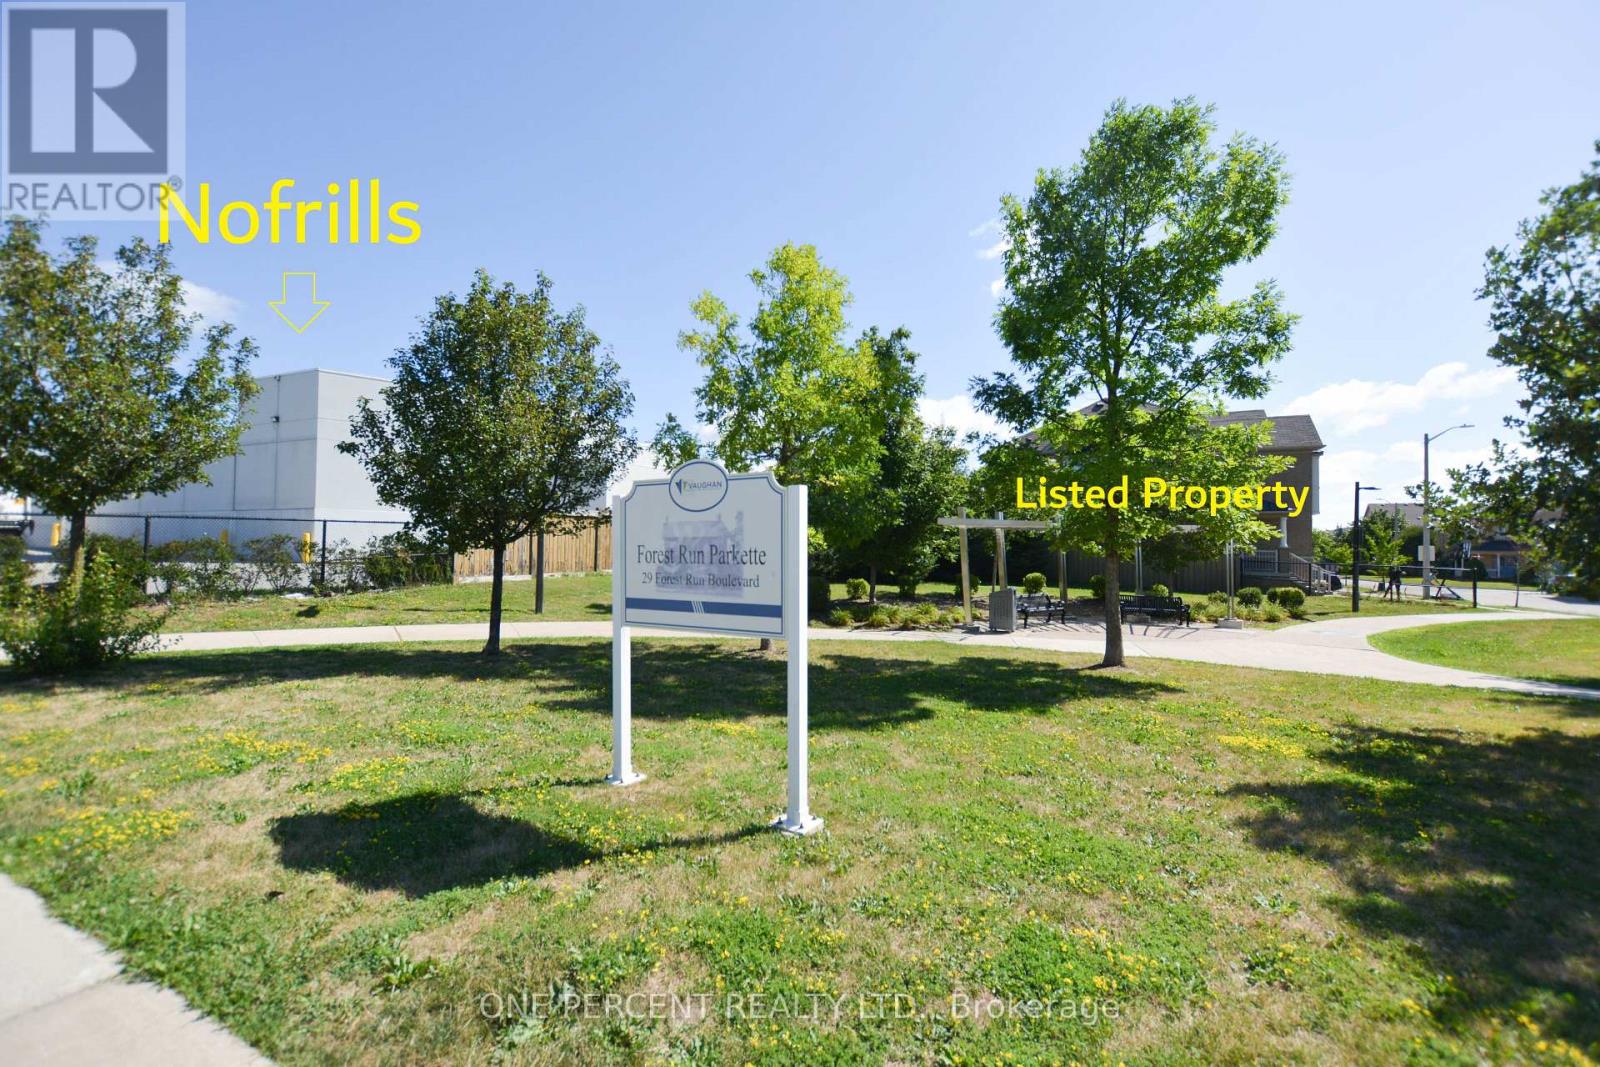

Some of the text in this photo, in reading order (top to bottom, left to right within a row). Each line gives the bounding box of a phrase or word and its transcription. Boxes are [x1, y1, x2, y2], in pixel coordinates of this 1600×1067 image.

[637, 544, 767, 566] Forest Run Parkette
[641, 572, 760, 587] 29 Forest Run Boulevard
